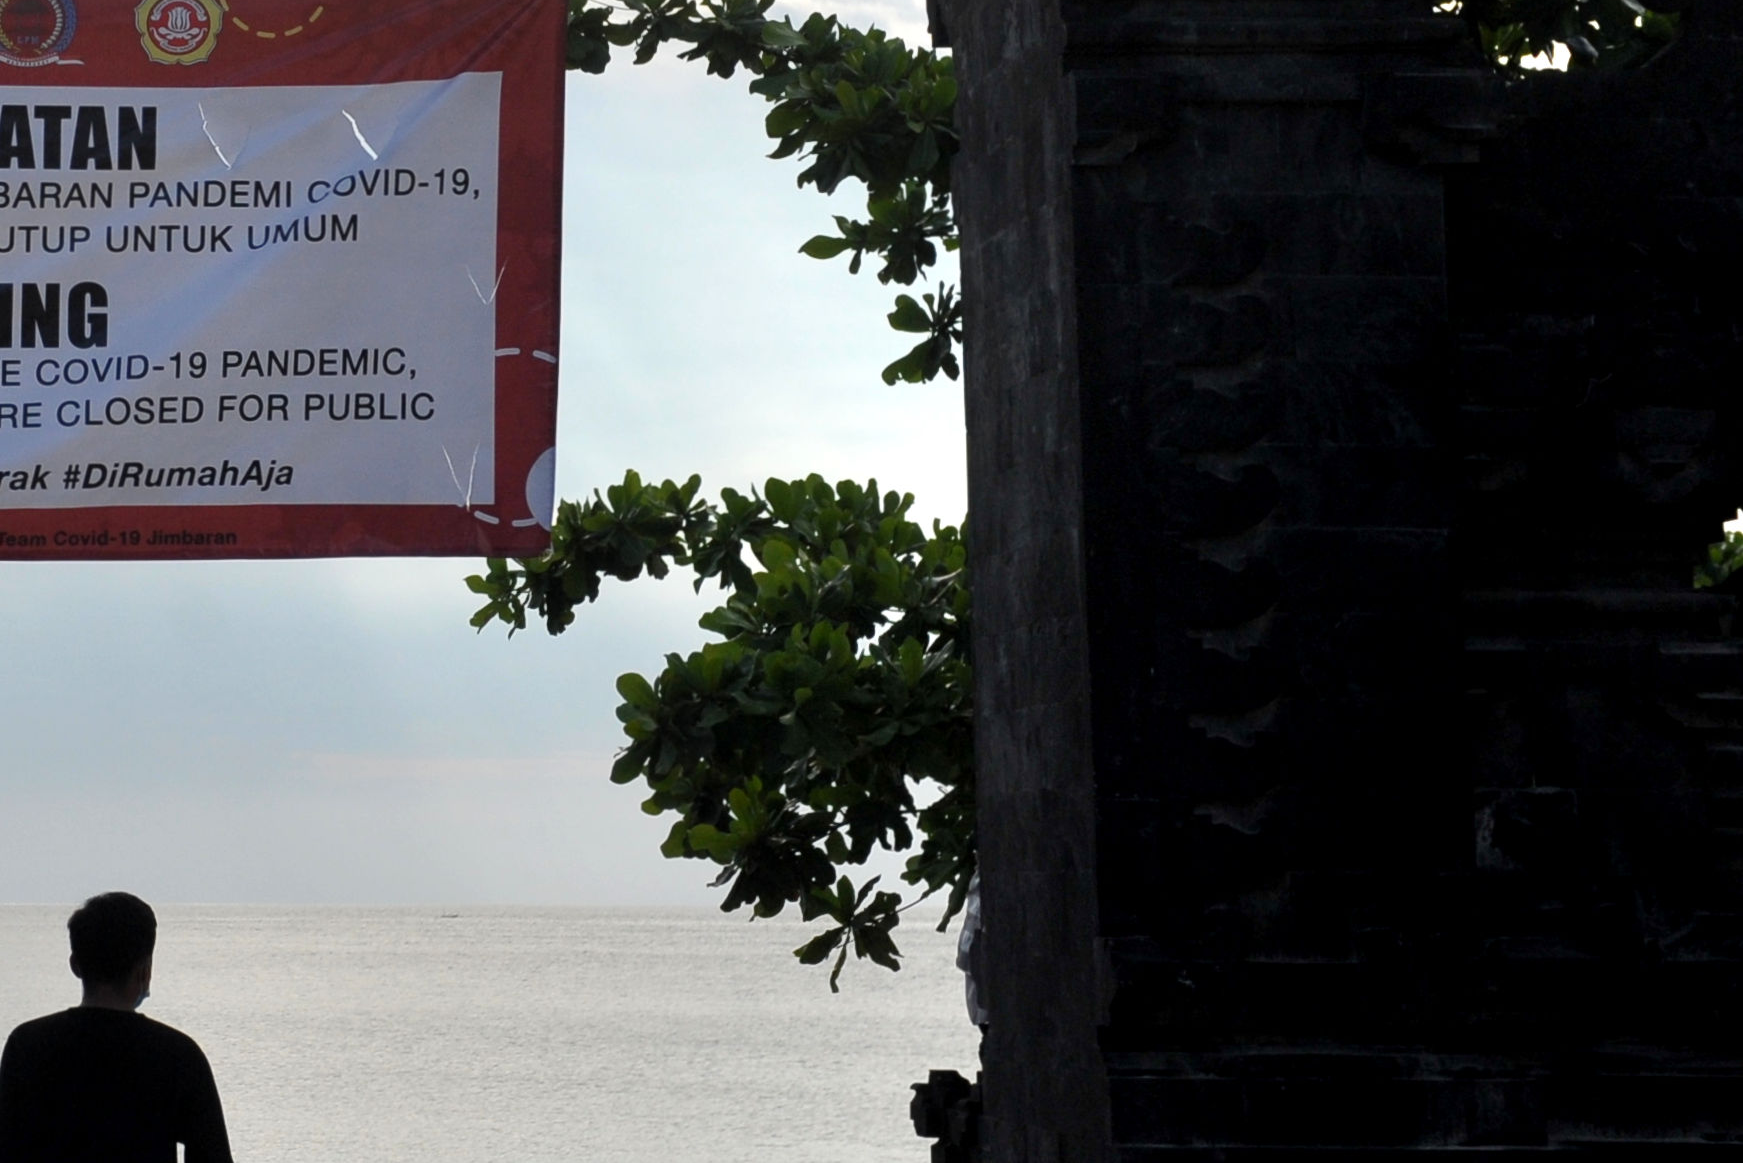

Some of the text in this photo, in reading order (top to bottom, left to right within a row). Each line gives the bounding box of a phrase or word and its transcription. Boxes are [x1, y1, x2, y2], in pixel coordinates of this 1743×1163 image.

[129, 180, 292, 209] PANDEMI
[307, 168, 480, 204] COVID-19,
[106, 224, 233, 253] UNTUK
[247, 213, 358, 250] UMUM
[35, 351, 207, 387] COVID-19
[222, 347, 416, 380] PANDEMIC,
[56, 396, 204, 428] CLOSED
[218, 393, 289, 422] FOR
[304, 392, 435, 421] PUBLIC
[62, 459, 294, 492] #DiRumahAja
[53, 529, 142, 547] Covid-19
[146, 529, 238, 547] Jimbaran
